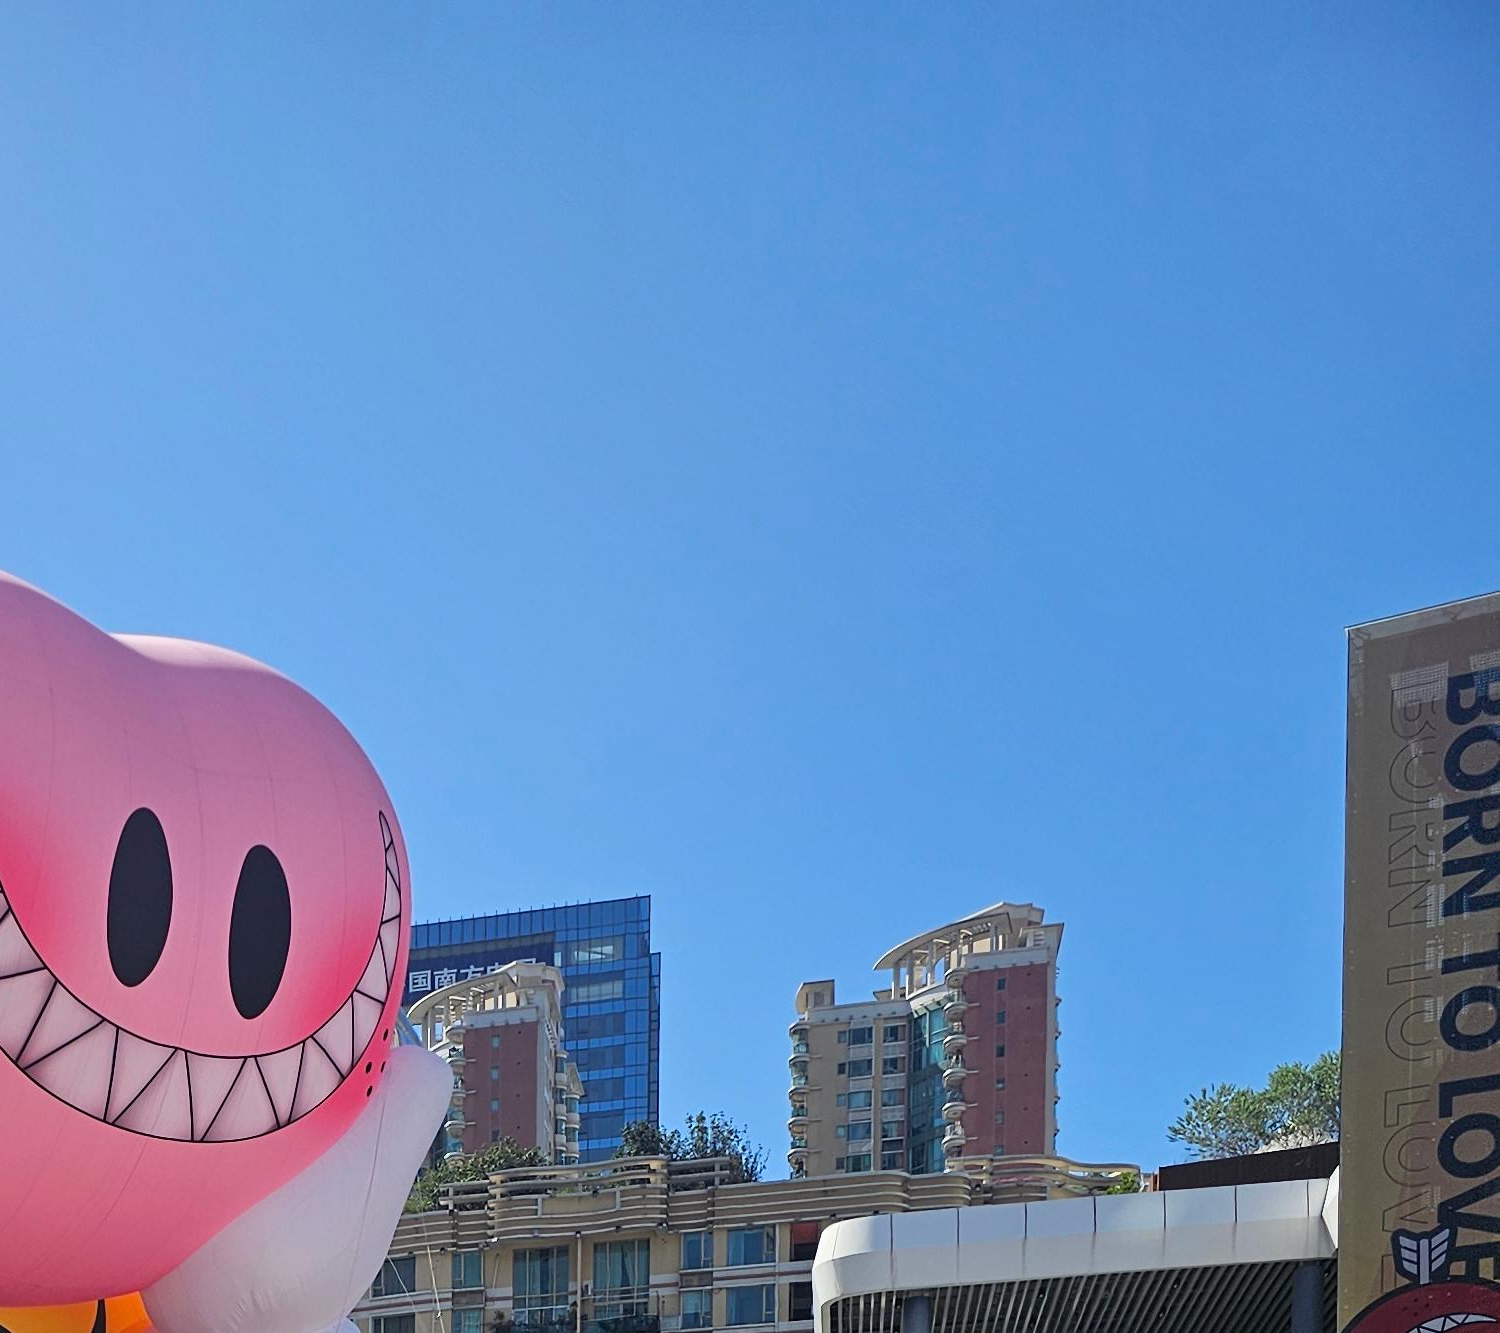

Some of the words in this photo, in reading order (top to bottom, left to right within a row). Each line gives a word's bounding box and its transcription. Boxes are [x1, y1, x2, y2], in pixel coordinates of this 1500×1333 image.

[1442, 667, 1500, 917] BORN
[409, 957, 537, 993] 国南方
